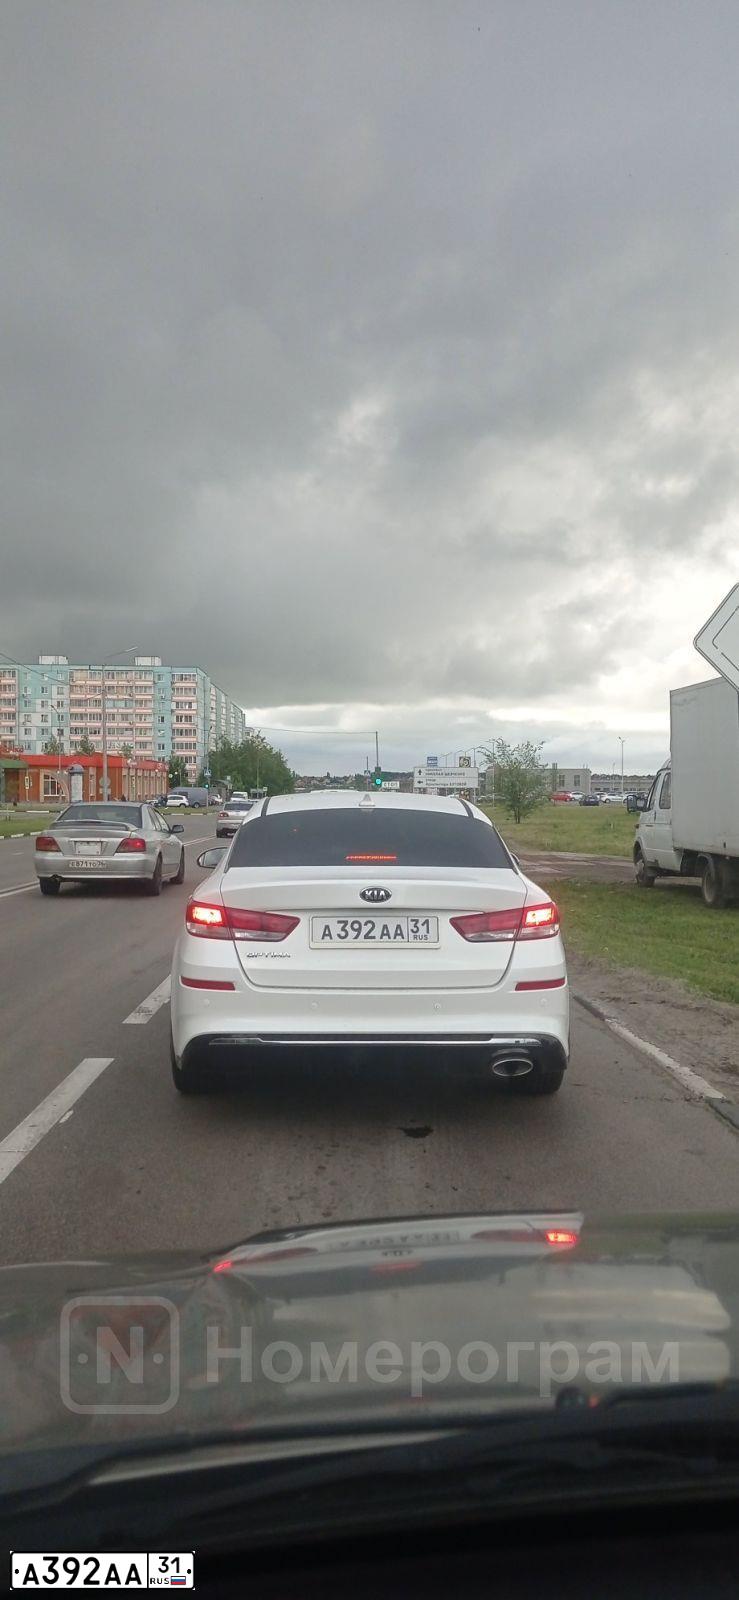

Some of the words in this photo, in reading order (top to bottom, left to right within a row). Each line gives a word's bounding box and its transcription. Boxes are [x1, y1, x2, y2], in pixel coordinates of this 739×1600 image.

[365, 890, 387, 900] KIA
[321, 919, 405, 941] А392АА
[410, 918, 430, 935] 31
